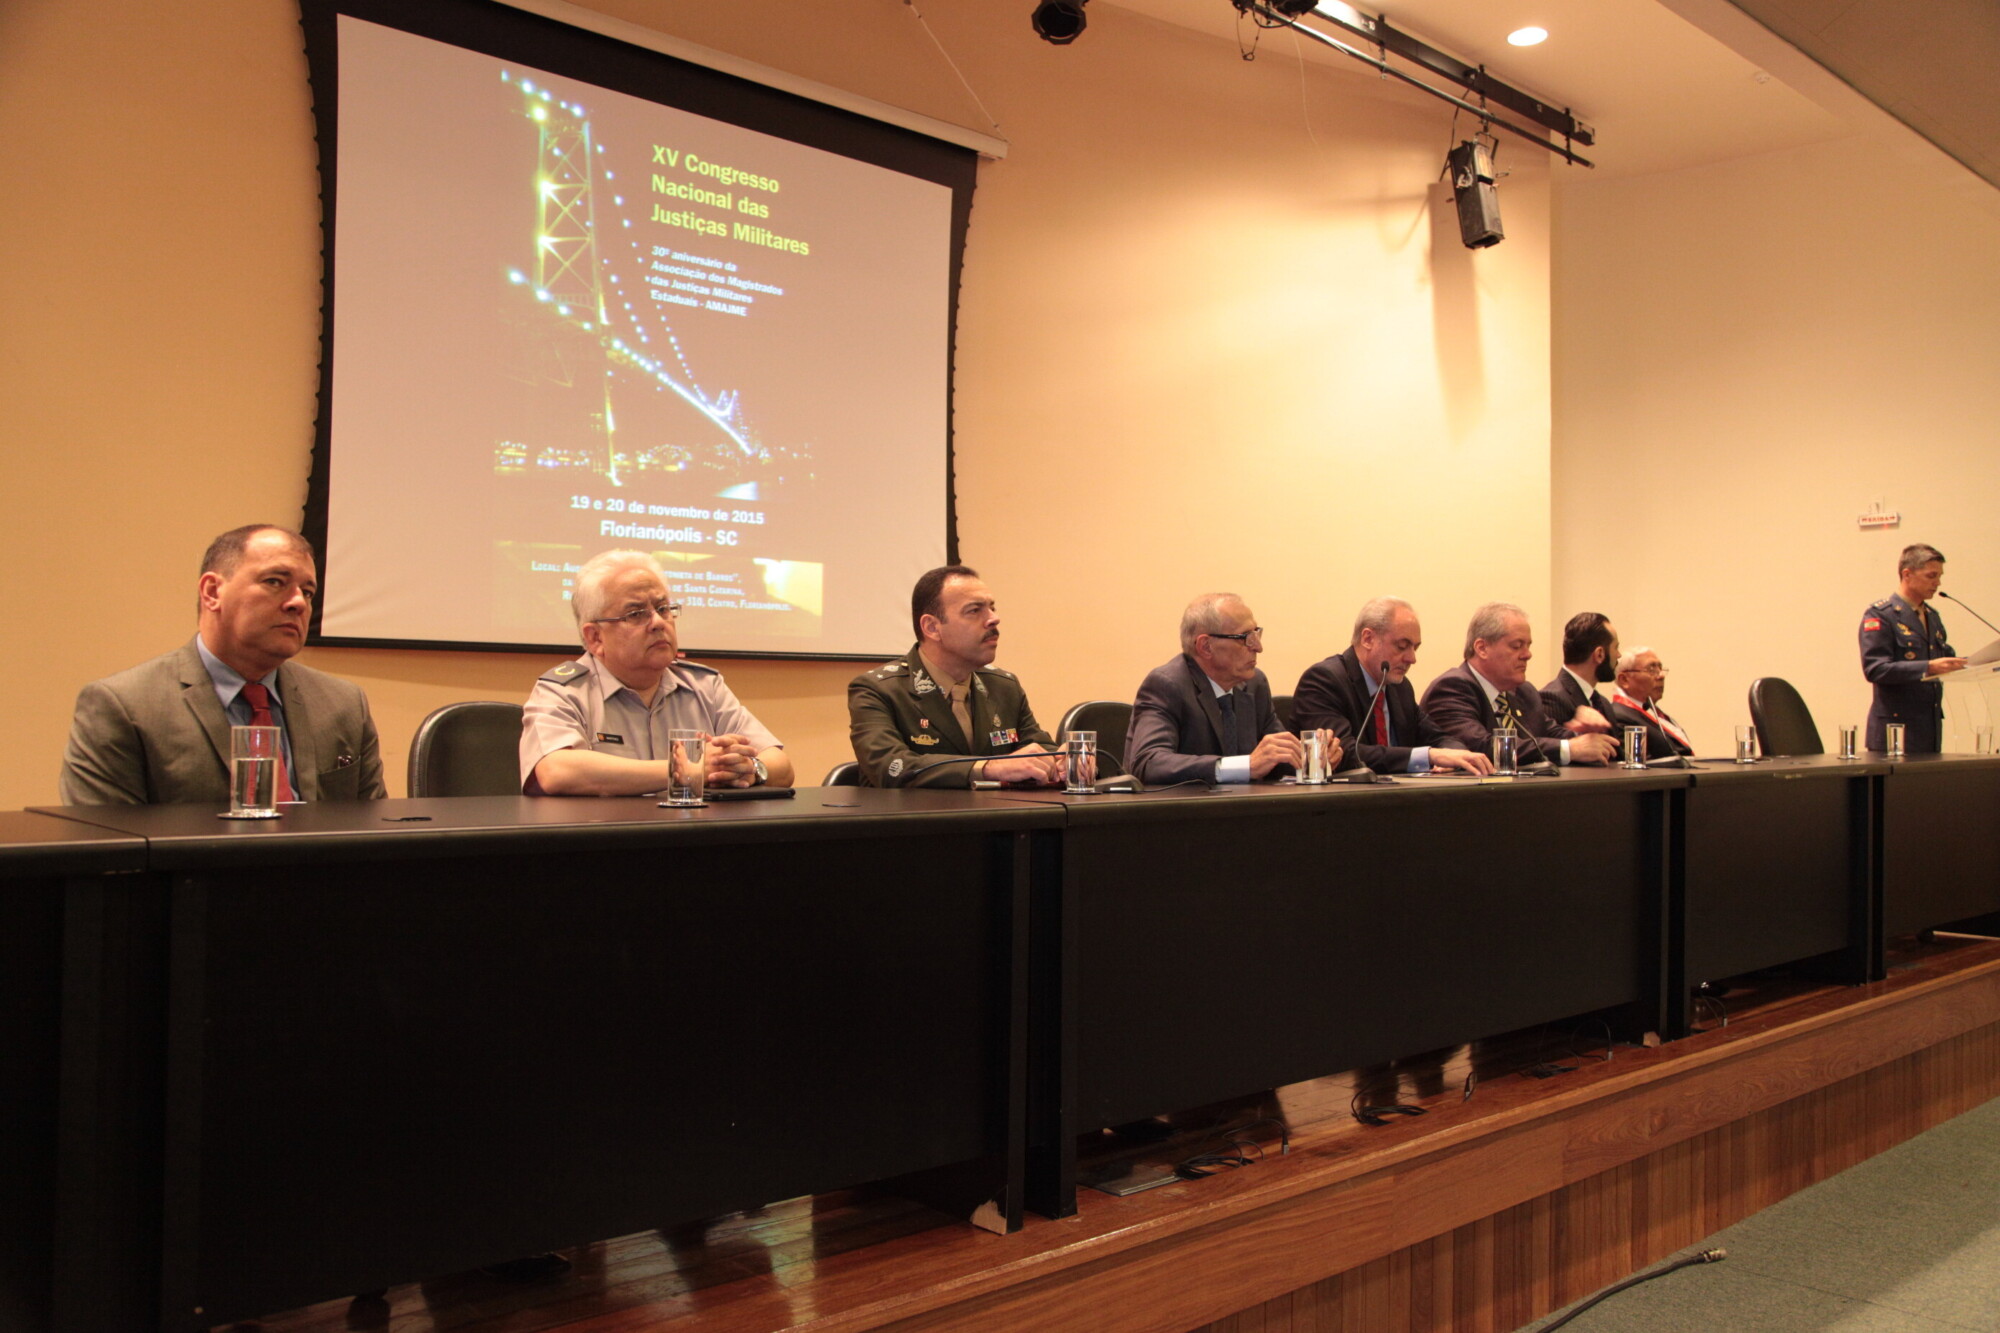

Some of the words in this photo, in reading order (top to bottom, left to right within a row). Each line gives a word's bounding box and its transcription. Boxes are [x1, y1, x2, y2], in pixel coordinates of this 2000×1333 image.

[652, 144, 679, 168] XV
[684, 153, 780, 194] Congresso
[651, 173, 733, 210] Nacional
[737, 197, 770, 219] das
[650, 203, 728, 237] Justiças
[733, 222, 810, 256] Militares
[671, 251, 723, 270] aniversário
[724, 262, 738, 272] da
[650, 260, 707, 281] Associação
[708, 272, 726, 285] dos
[727, 275, 784, 296] Magistrados
[650, 275, 670, 288] das
[670, 279, 711, 297] Justiças
[711, 287, 754, 304] Militares
[650, 288, 700, 308] Estaduais
[704, 299, 748, 318] AMAJME
[570, 495, 591, 510] 19
[592, 499, 604, 511] e
[605, 498, 626, 513] 20
[628, 500, 647, 514] de
[648, 504, 711, 521] novembro
[712, 508, 730, 522] de
[731, 509, 766, 525] 2015
[599, 519, 704, 544] Florianópolis
[715, 529, 739, 547] SC
